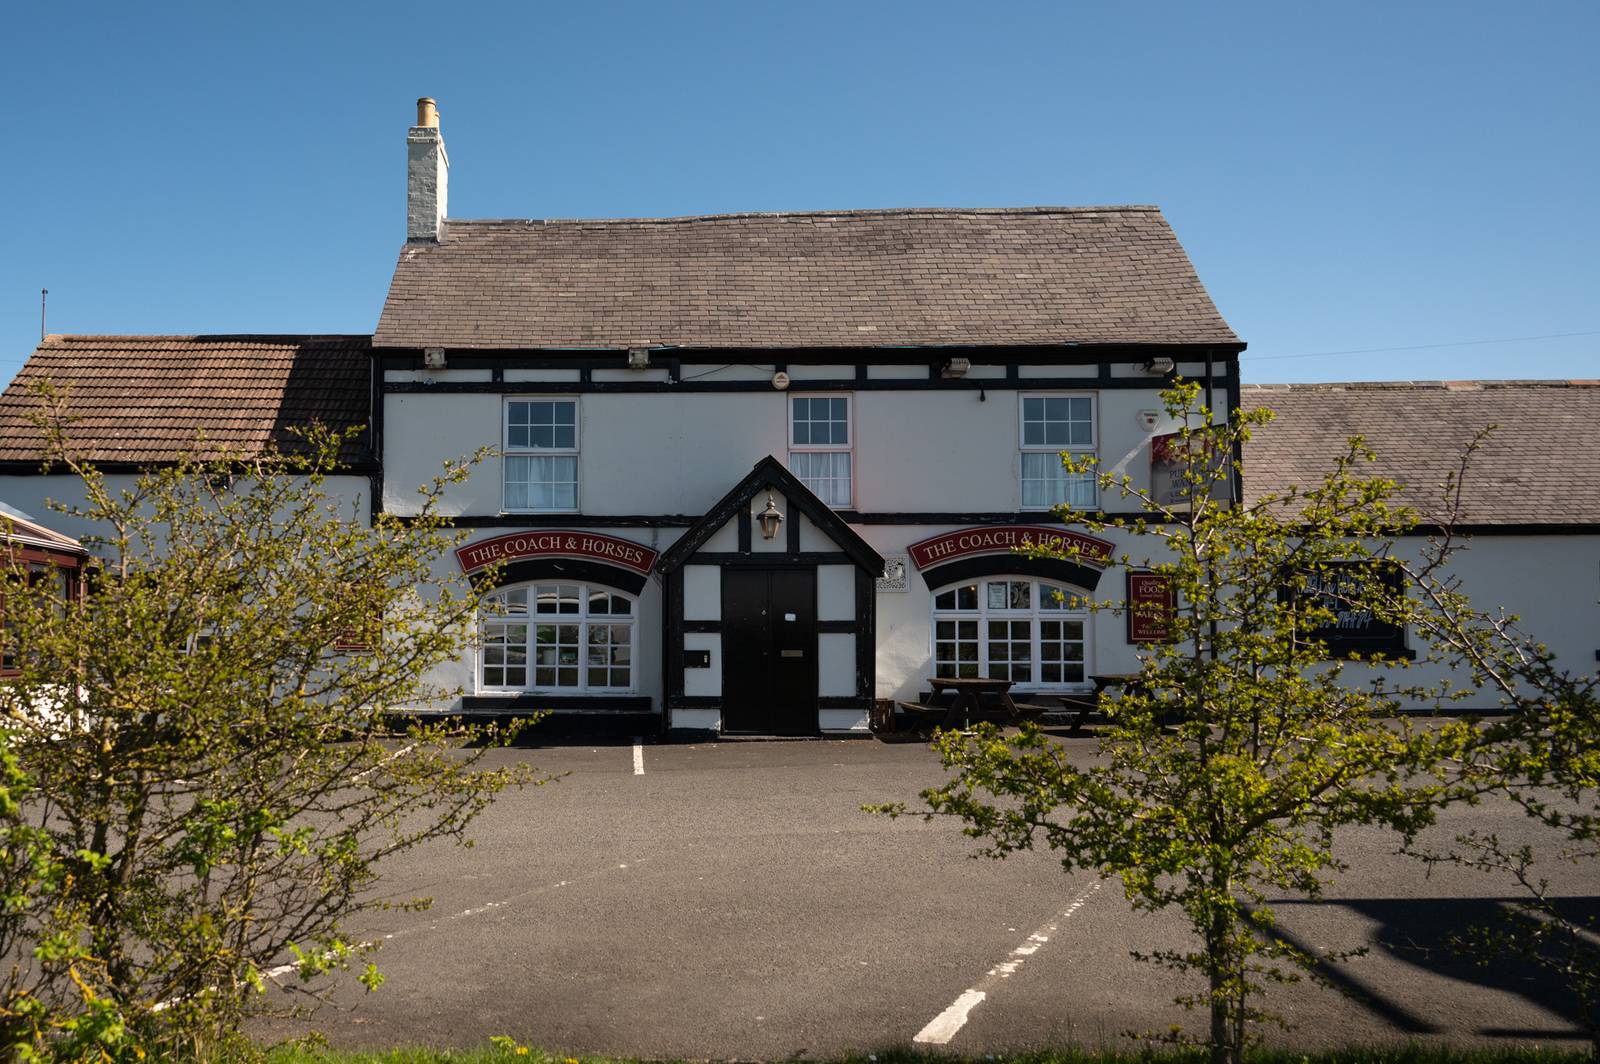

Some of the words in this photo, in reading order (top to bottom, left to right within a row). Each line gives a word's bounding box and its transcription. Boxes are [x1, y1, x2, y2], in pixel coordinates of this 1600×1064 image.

[469, 543, 502, 564] THE
[504, 536, 561, 555] COACH
[564, 536, 577, 550] &
[582, 539, 644, 564] HORSES
[923, 539, 957, 560] THE
[959, 531, 1016, 550] COACH
[1020, 531, 1032, 546] &
